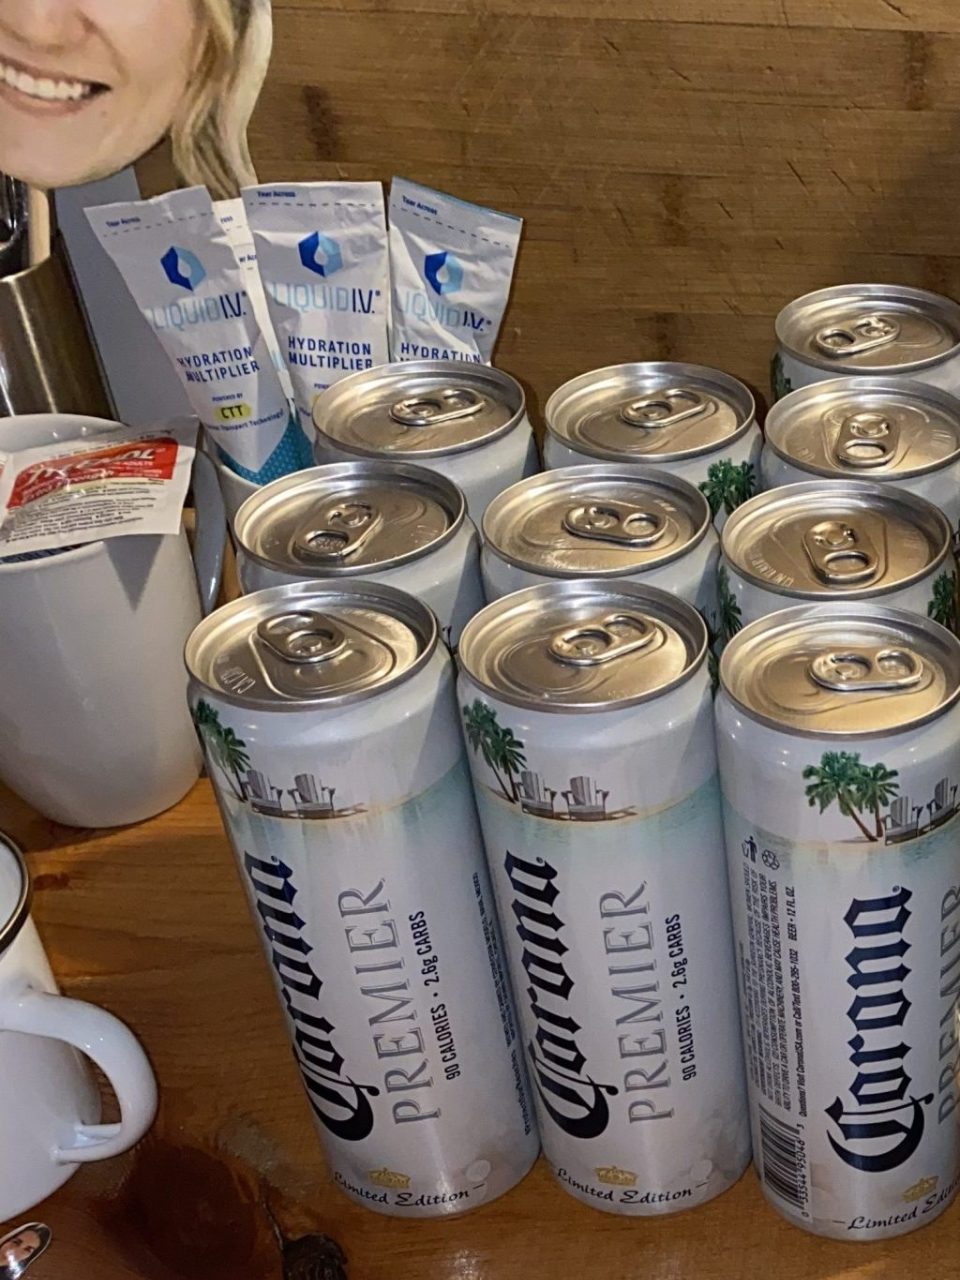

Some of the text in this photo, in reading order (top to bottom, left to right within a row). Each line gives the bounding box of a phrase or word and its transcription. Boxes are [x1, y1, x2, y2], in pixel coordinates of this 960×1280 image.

[177, 346, 254, 369] HYDRATION
[287, 335, 372, 355] HYDRATION
[287, 350, 373, 371] MULTIPLIER
[185, 360, 260, 383] MULTIPLIER
[220, 404, 244, 419] CTT
[787, 922, 798, 942] BEER
[244, 849, 381, 1142] Corona
[337, 877, 440, 1126] PREMIER
[408, 910, 461, 1081] 90 CALORIES 2.6g CARBS
[503, 849, 620, 1139] Corona
[598, 880, 674, 1125] PREMIER
[664, 913, 697, 1082] 90 CALORIES 2.6g CARBS
[824, 886, 936, 1173] Corona
[332, 1171, 471, 1207] Limited Edition
[556, 1168, 694, 1205] Limited Edition
[847, 1207, 919, 1231] Limited
